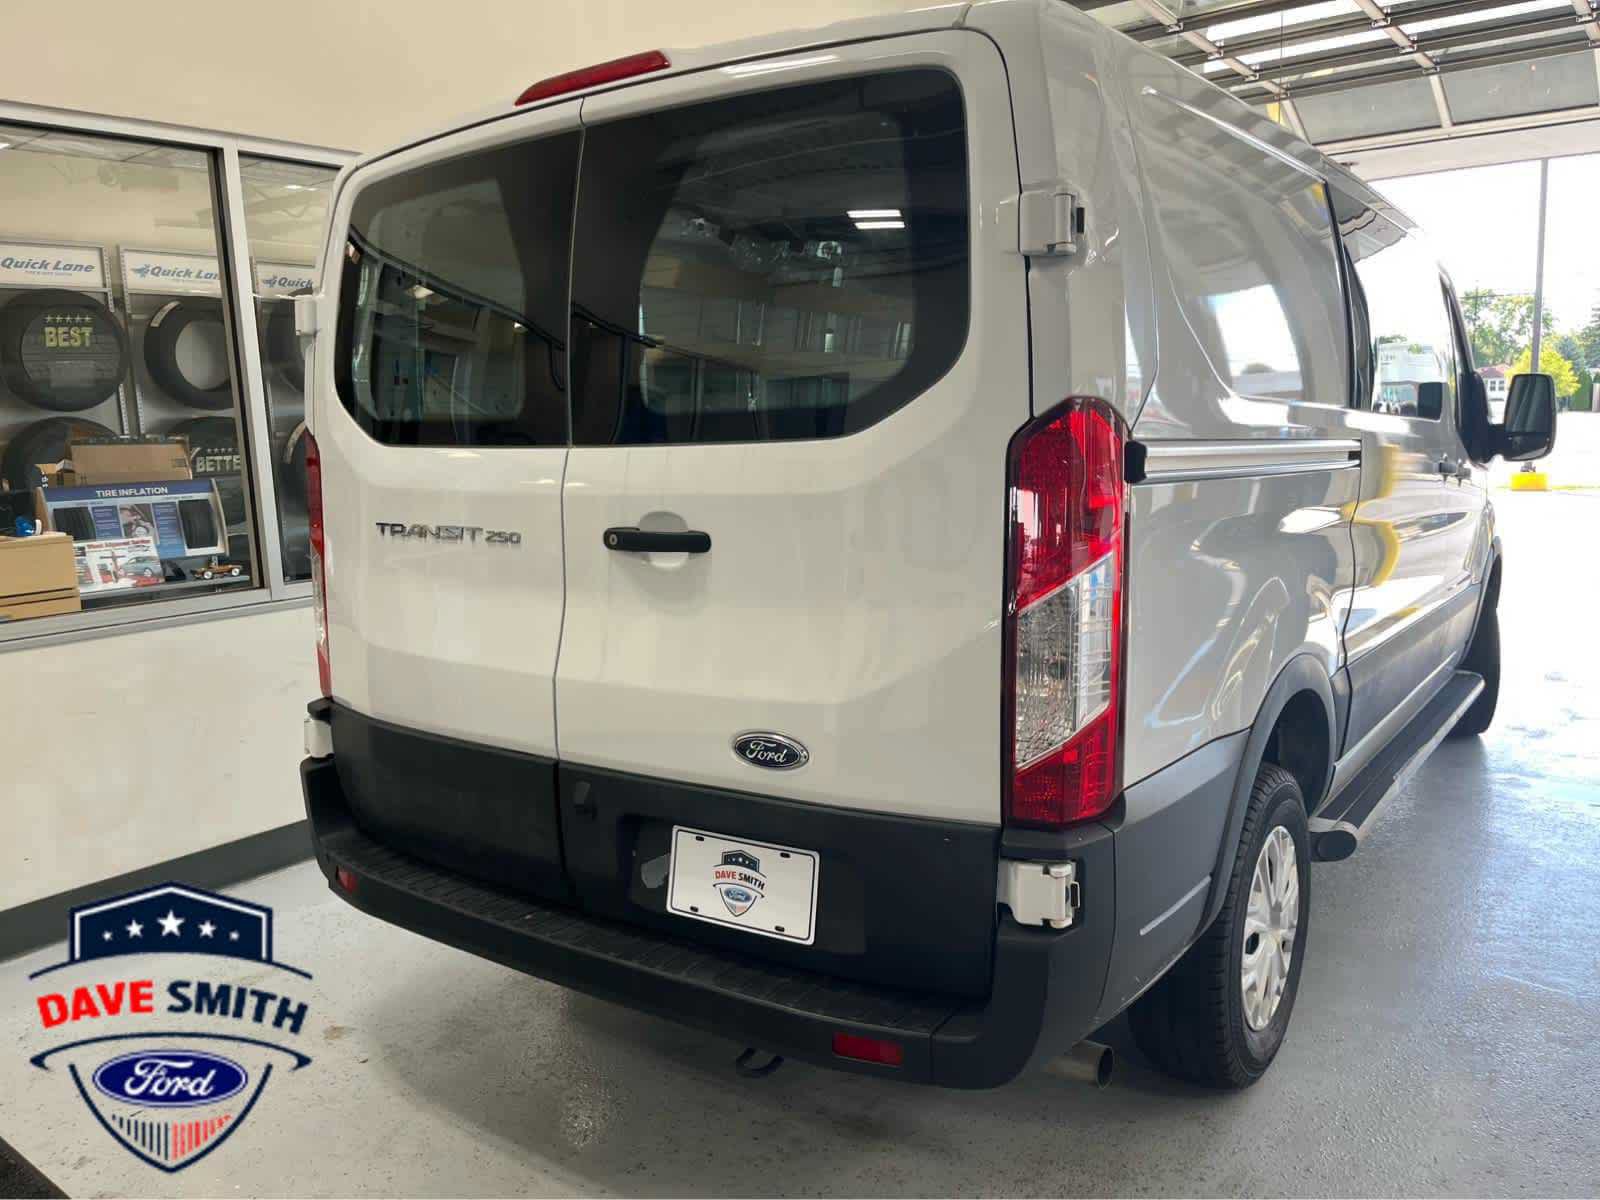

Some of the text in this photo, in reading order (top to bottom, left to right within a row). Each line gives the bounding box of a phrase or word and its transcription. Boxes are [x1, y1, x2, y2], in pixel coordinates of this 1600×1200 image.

[1, 257, 95, 272] Quick Lane
[150, 265, 218, 280] Quick La
[45, 326, 93, 348] BEST
[196, 454, 241, 473] BETTE
[96, 486, 168, 498] TIRE INFLATION
[376, 522, 521, 544] TRANSIT 250
[746, 740, 787, 763] Ford
[715, 870, 765, 890] DAVE SMITH
